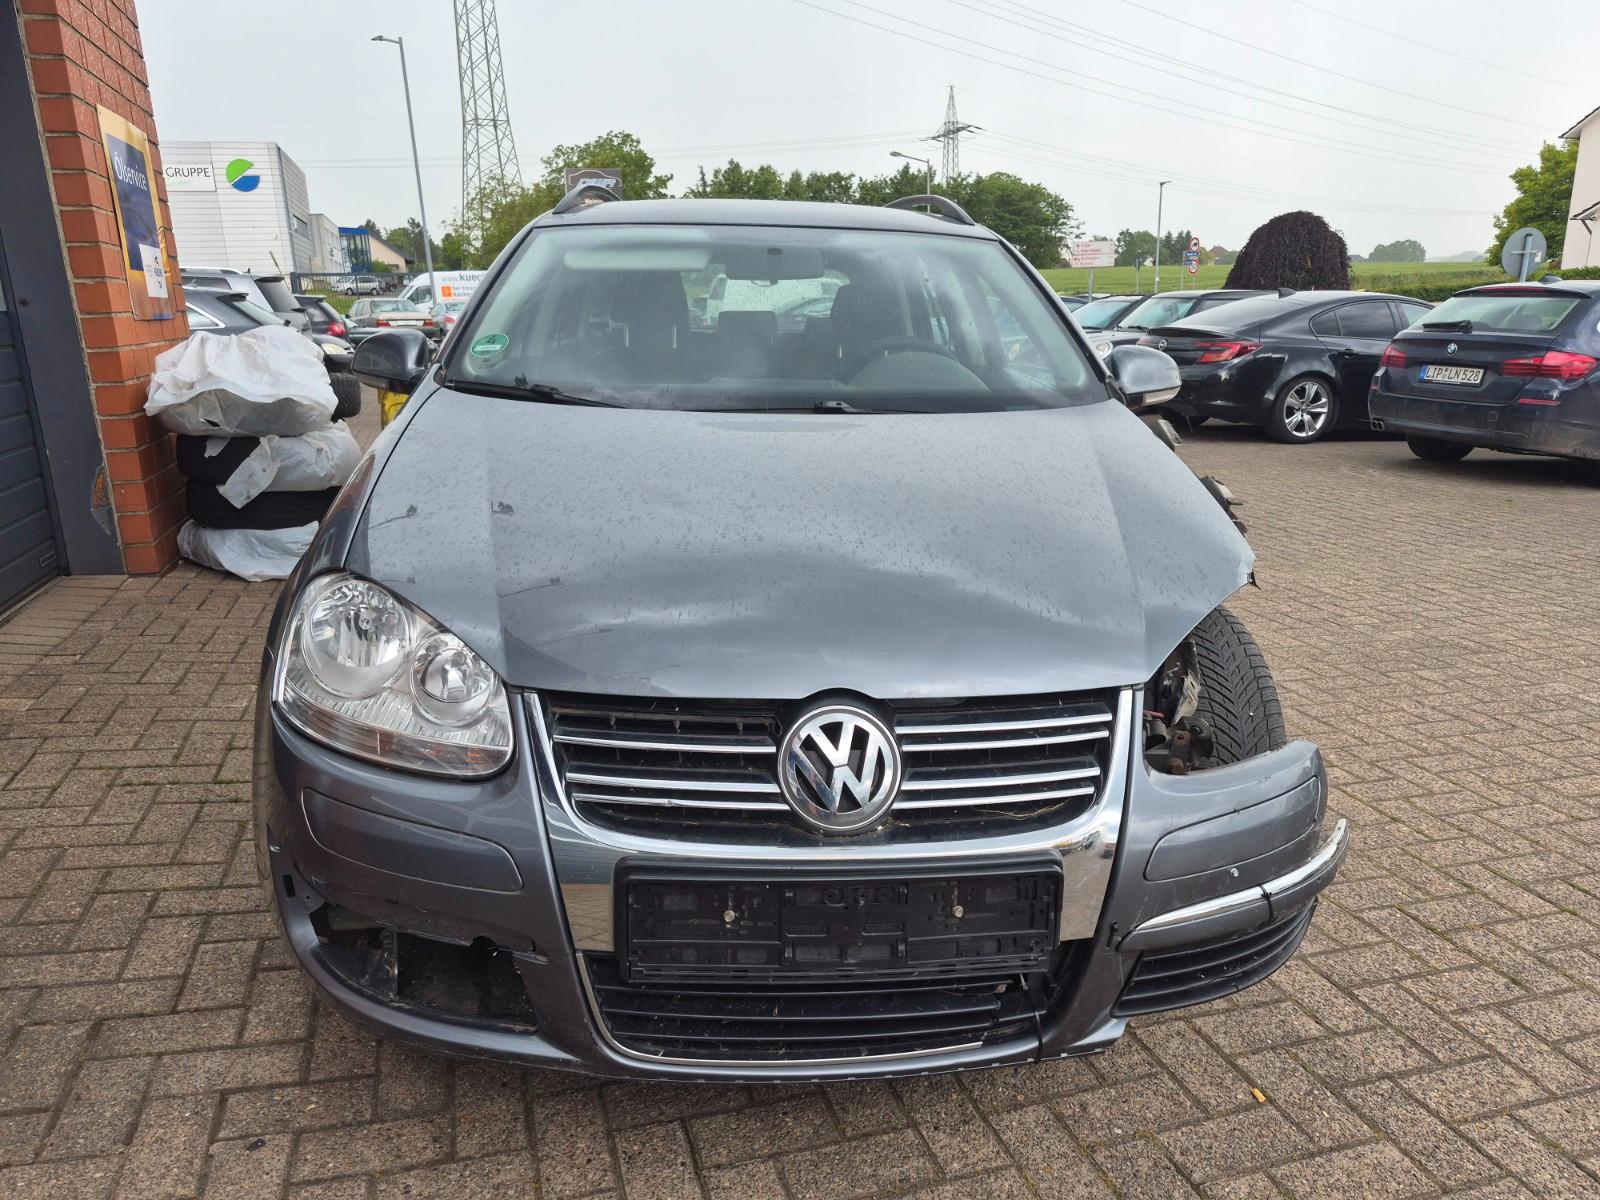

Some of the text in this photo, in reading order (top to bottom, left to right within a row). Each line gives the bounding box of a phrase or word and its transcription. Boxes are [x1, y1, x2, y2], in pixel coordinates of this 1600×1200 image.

[113, 152, 147, 191] Ölservice
[165, 167, 211, 178] GRUPPE
[1426, 367, 1443, 379] LIP
[1462, 369, 1481, 382] 528
[786, 711, 893, 820] VW
